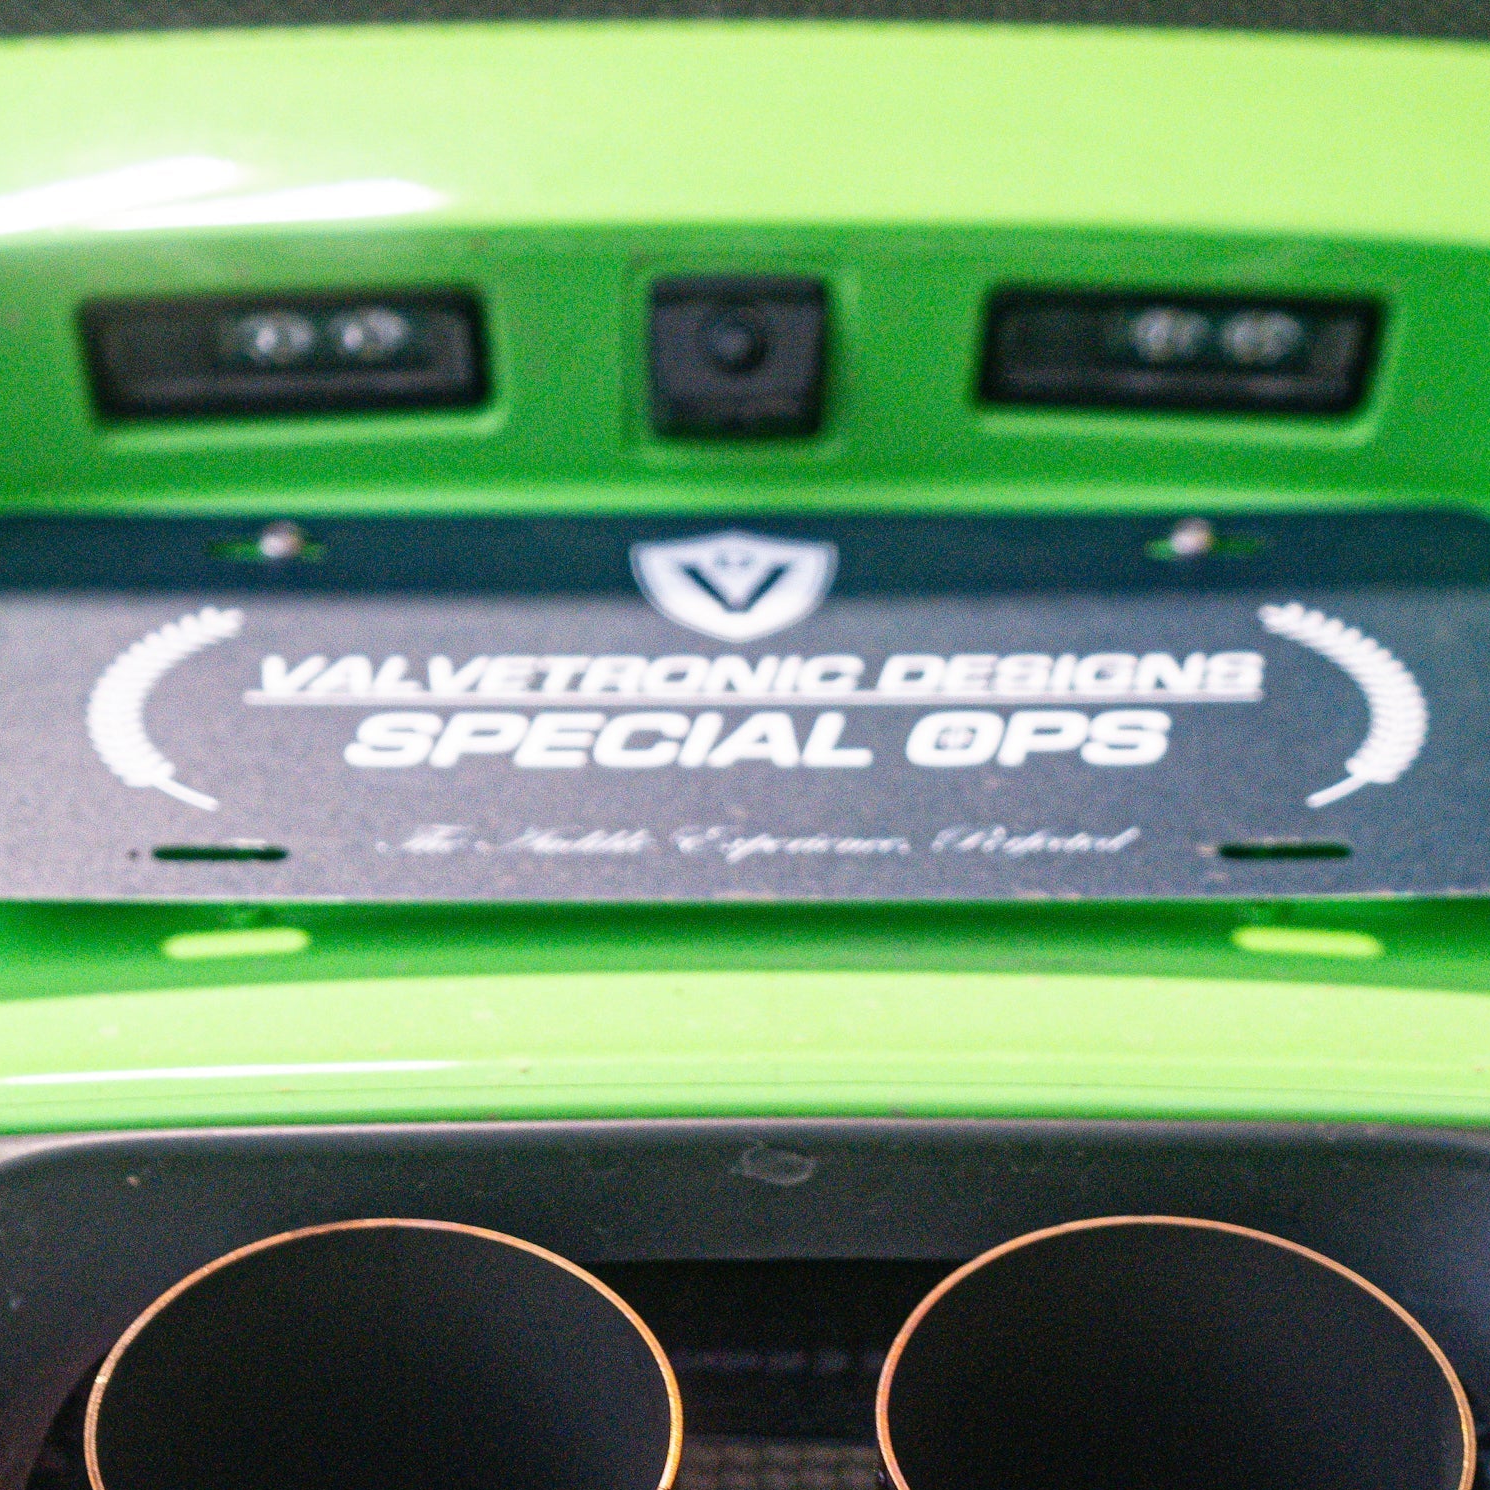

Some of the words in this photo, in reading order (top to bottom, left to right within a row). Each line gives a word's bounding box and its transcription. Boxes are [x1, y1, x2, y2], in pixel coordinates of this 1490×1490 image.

[259, 653, 867, 698] VALVETRONIC
[877, 651, 1266, 698] DESIGNS
[342, 711, 874, 769] SPECIAL
[905, 709, 1173, 768] OPS
